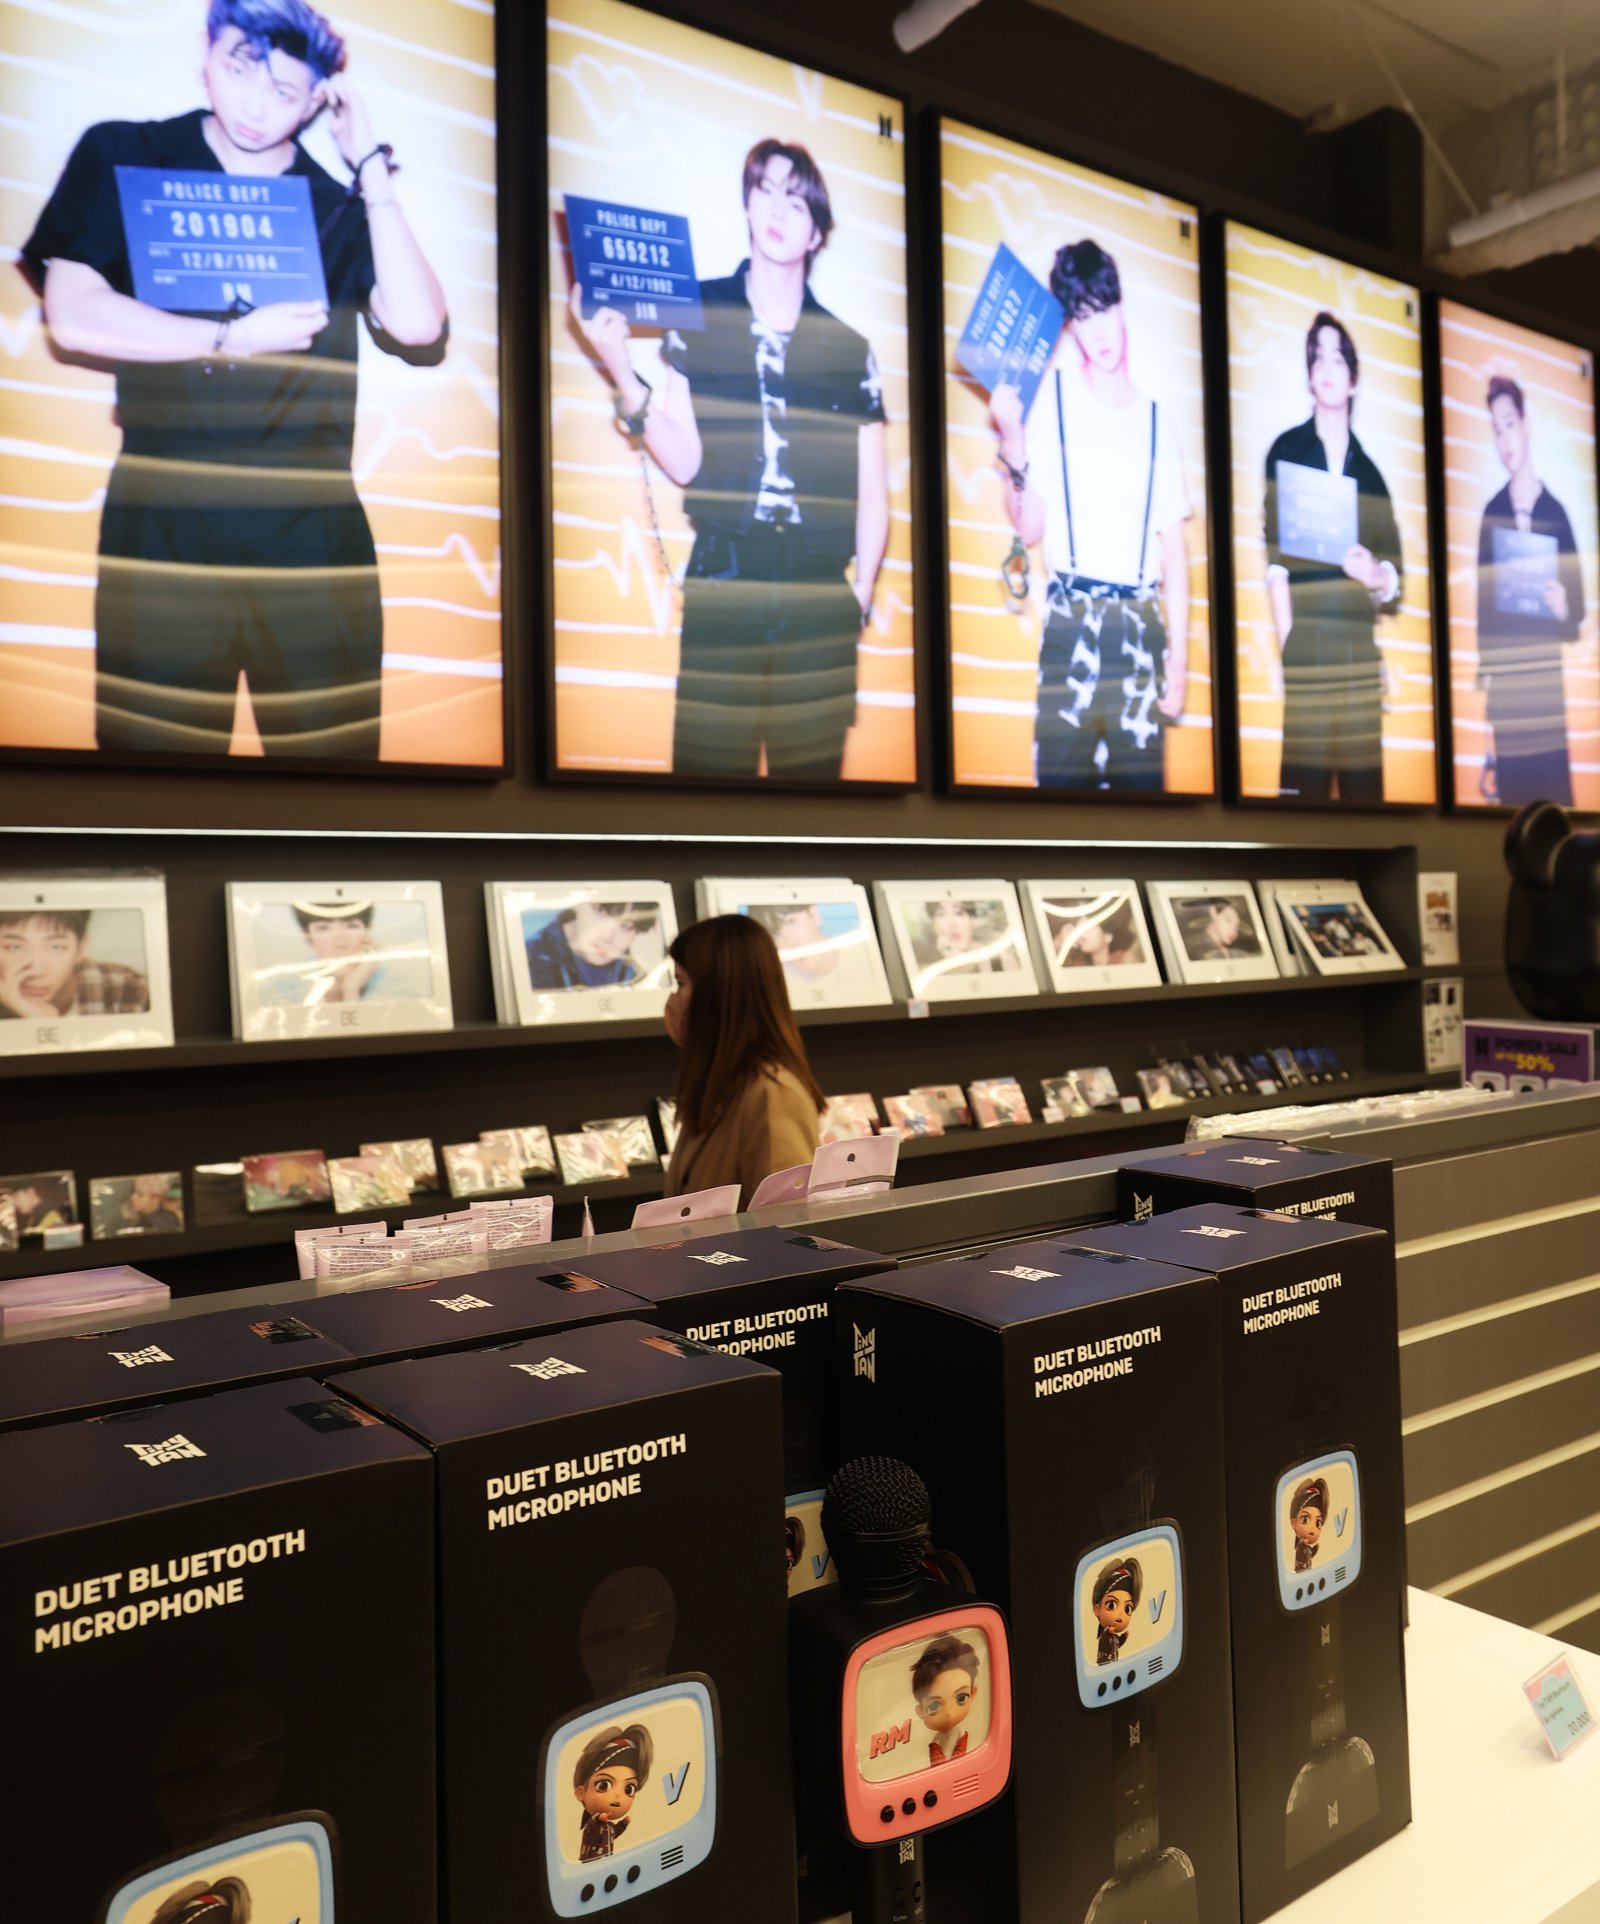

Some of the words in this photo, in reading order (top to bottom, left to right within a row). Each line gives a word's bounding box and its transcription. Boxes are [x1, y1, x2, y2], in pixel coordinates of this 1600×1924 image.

[162, 181, 223, 202] POLICE
[229, 185, 270, 203] DEPT
[171, 211, 273, 239] 201904
[36, 1026, 60, 1044] BE
[1516, 1053, 1556, 1073] 50%
[1300, 1191, 1356, 1215] BLUETOOTH
[1242, 1290, 1275, 1314] DUET
[1275, 1272, 1342, 1304] BLUETOOTH
[686, 1320, 732, 1342] DUET
[733, 1302, 829, 1335] BLUETOOTH
[1243, 1299, 1320, 1335] MICROPHONE
[853, 1350, 876, 1384] TAN
[1033, 1348, 1075, 1374] DUET
[1076, 1325, 1162, 1363] BLUETOOTH
[1034, 1356, 1134, 1399] MICROPHONE
[486, 1465, 550, 1501] DUET
[554, 1433, 687, 1484] BLUETOOTH
[487, 1473, 642, 1531] MICROPHONE
[1333, 1507, 1348, 1538] V
[35, 1572, 123, 1618] DUET
[128, 1528, 306, 1594] BLUETOOTH
[811, 1550, 830, 1580] V
[34, 1577, 245, 1654] MICROPHONE
[1147, 1589, 1167, 1625] V
[869, 1717, 912, 1760] RM
[661, 1761, 691, 1807] V
